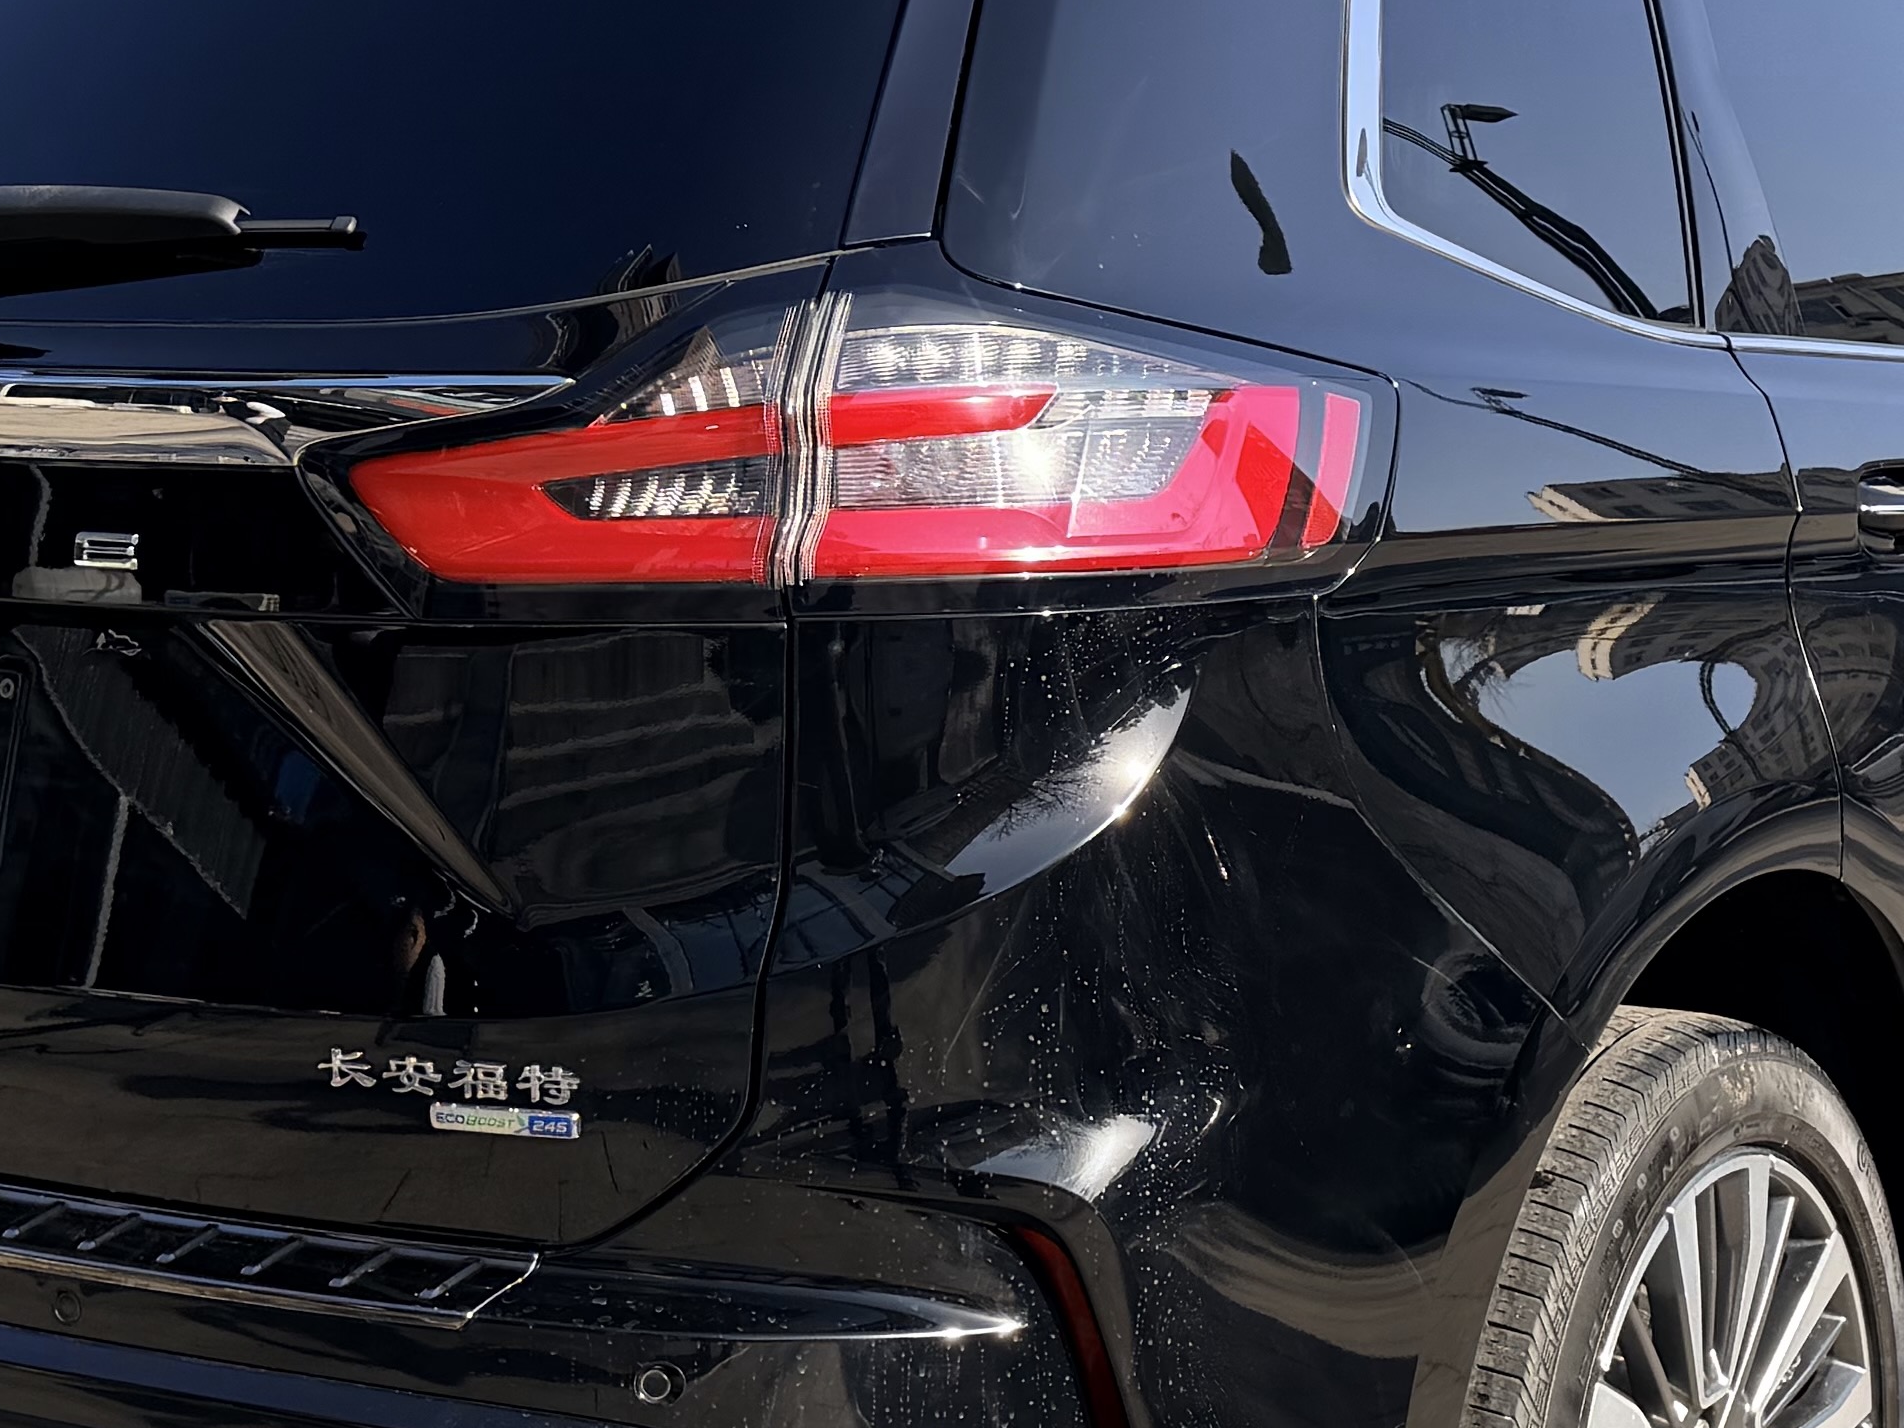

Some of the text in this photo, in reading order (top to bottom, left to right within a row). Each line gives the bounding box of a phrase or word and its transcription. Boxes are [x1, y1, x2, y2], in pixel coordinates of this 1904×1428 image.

[317, 1047, 581, 1106] 长安福特
[532, 1120, 568, 1134] 245
